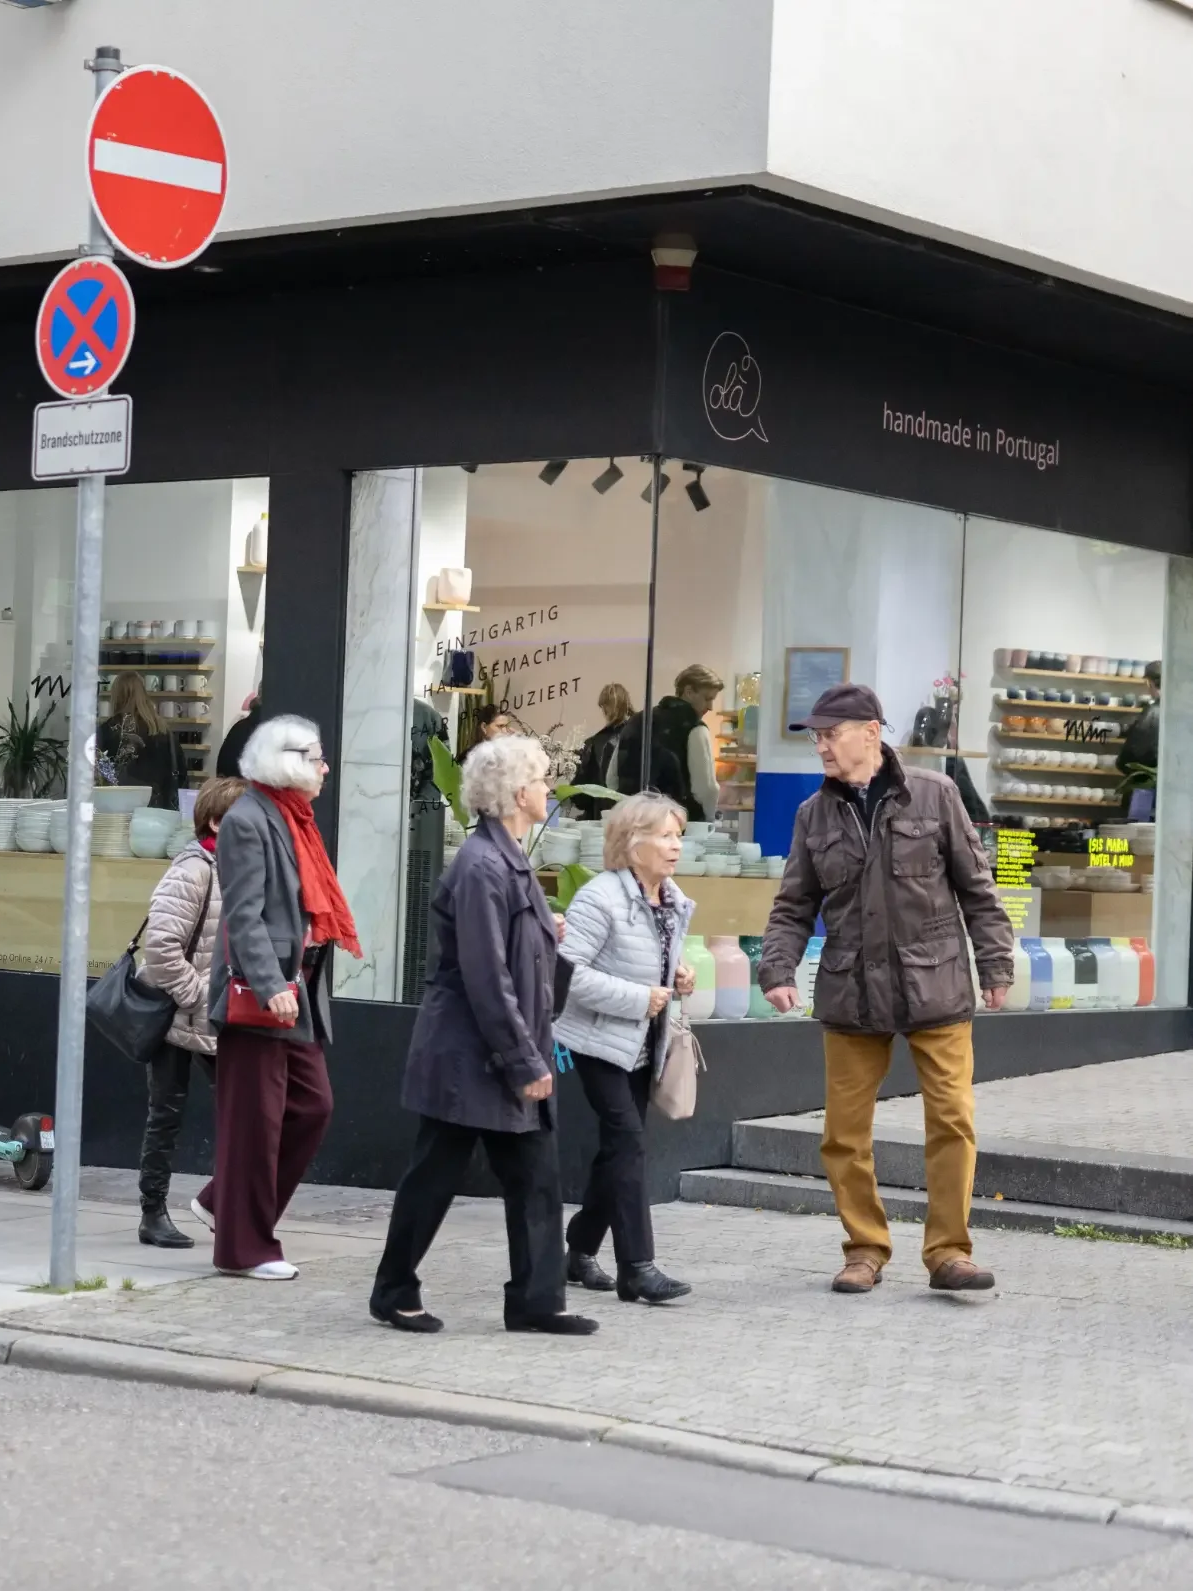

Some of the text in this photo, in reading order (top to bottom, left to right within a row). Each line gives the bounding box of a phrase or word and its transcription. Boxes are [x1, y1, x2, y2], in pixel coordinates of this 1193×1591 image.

[40, 429, 122, 450] Brandschutzzone
[883, 401, 1059, 470] handmade in Portugal
[436, 605, 559, 657] EINZIGARTIG
[460, 677, 582, 721] PRDUZIERT
[1088, 837, 1103, 853] ISIS
[9, 953, 32, 964] Online
